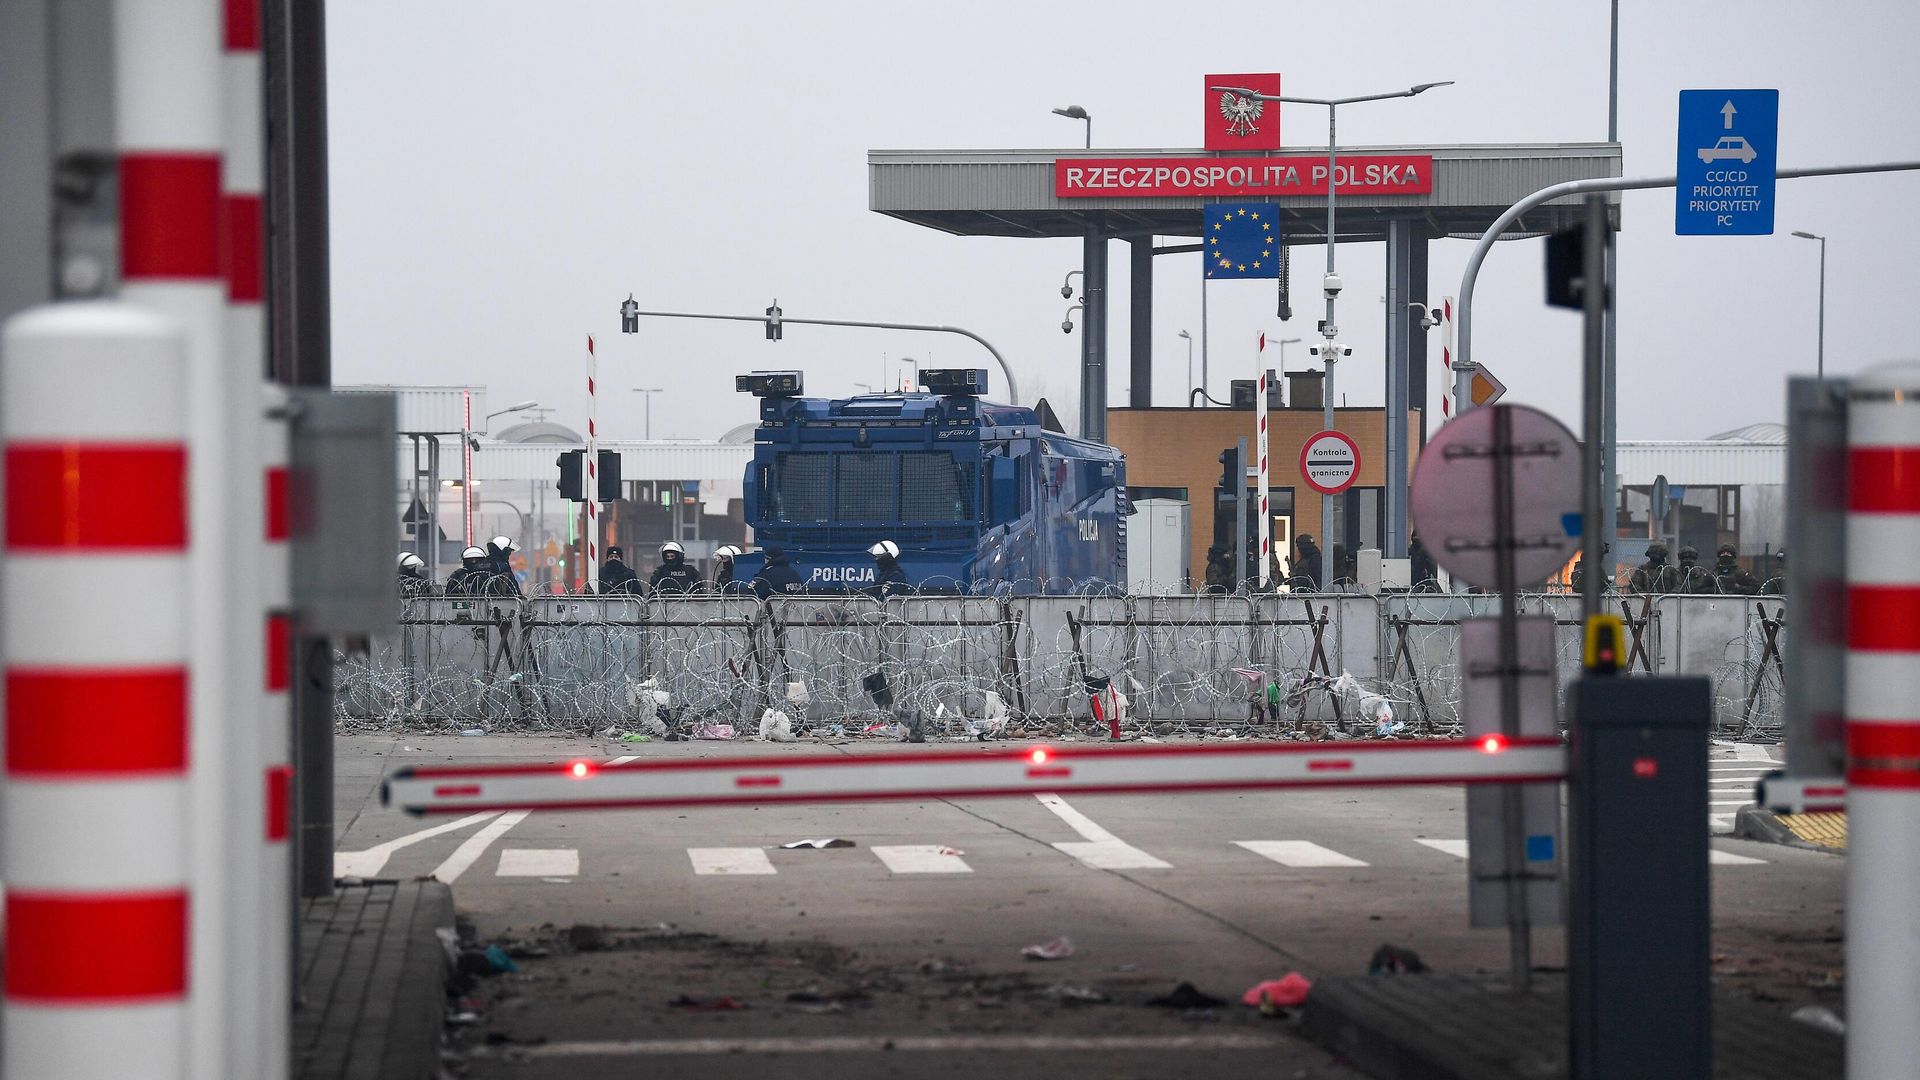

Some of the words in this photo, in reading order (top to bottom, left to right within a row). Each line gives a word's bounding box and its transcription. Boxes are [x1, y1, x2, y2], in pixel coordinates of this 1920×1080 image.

[1066, 166, 1301, 188] RZECZPOSPOLITA
[1312, 164, 1420, 186] POLSKA
[1706, 171, 1747, 183] CC/CD
[1693, 185, 1759, 197] PRIORYTET
[1689, 200, 1761, 212] PRIORYTETY
[1717, 215, 1733, 226] PC
[1313, 448, 1347, 456] Kontrola
[1311, 469, 1350, 478] graniczna
[1079, 519, 1099, 541] POLICJA
[813, 567, 875, 582] POLICJA
